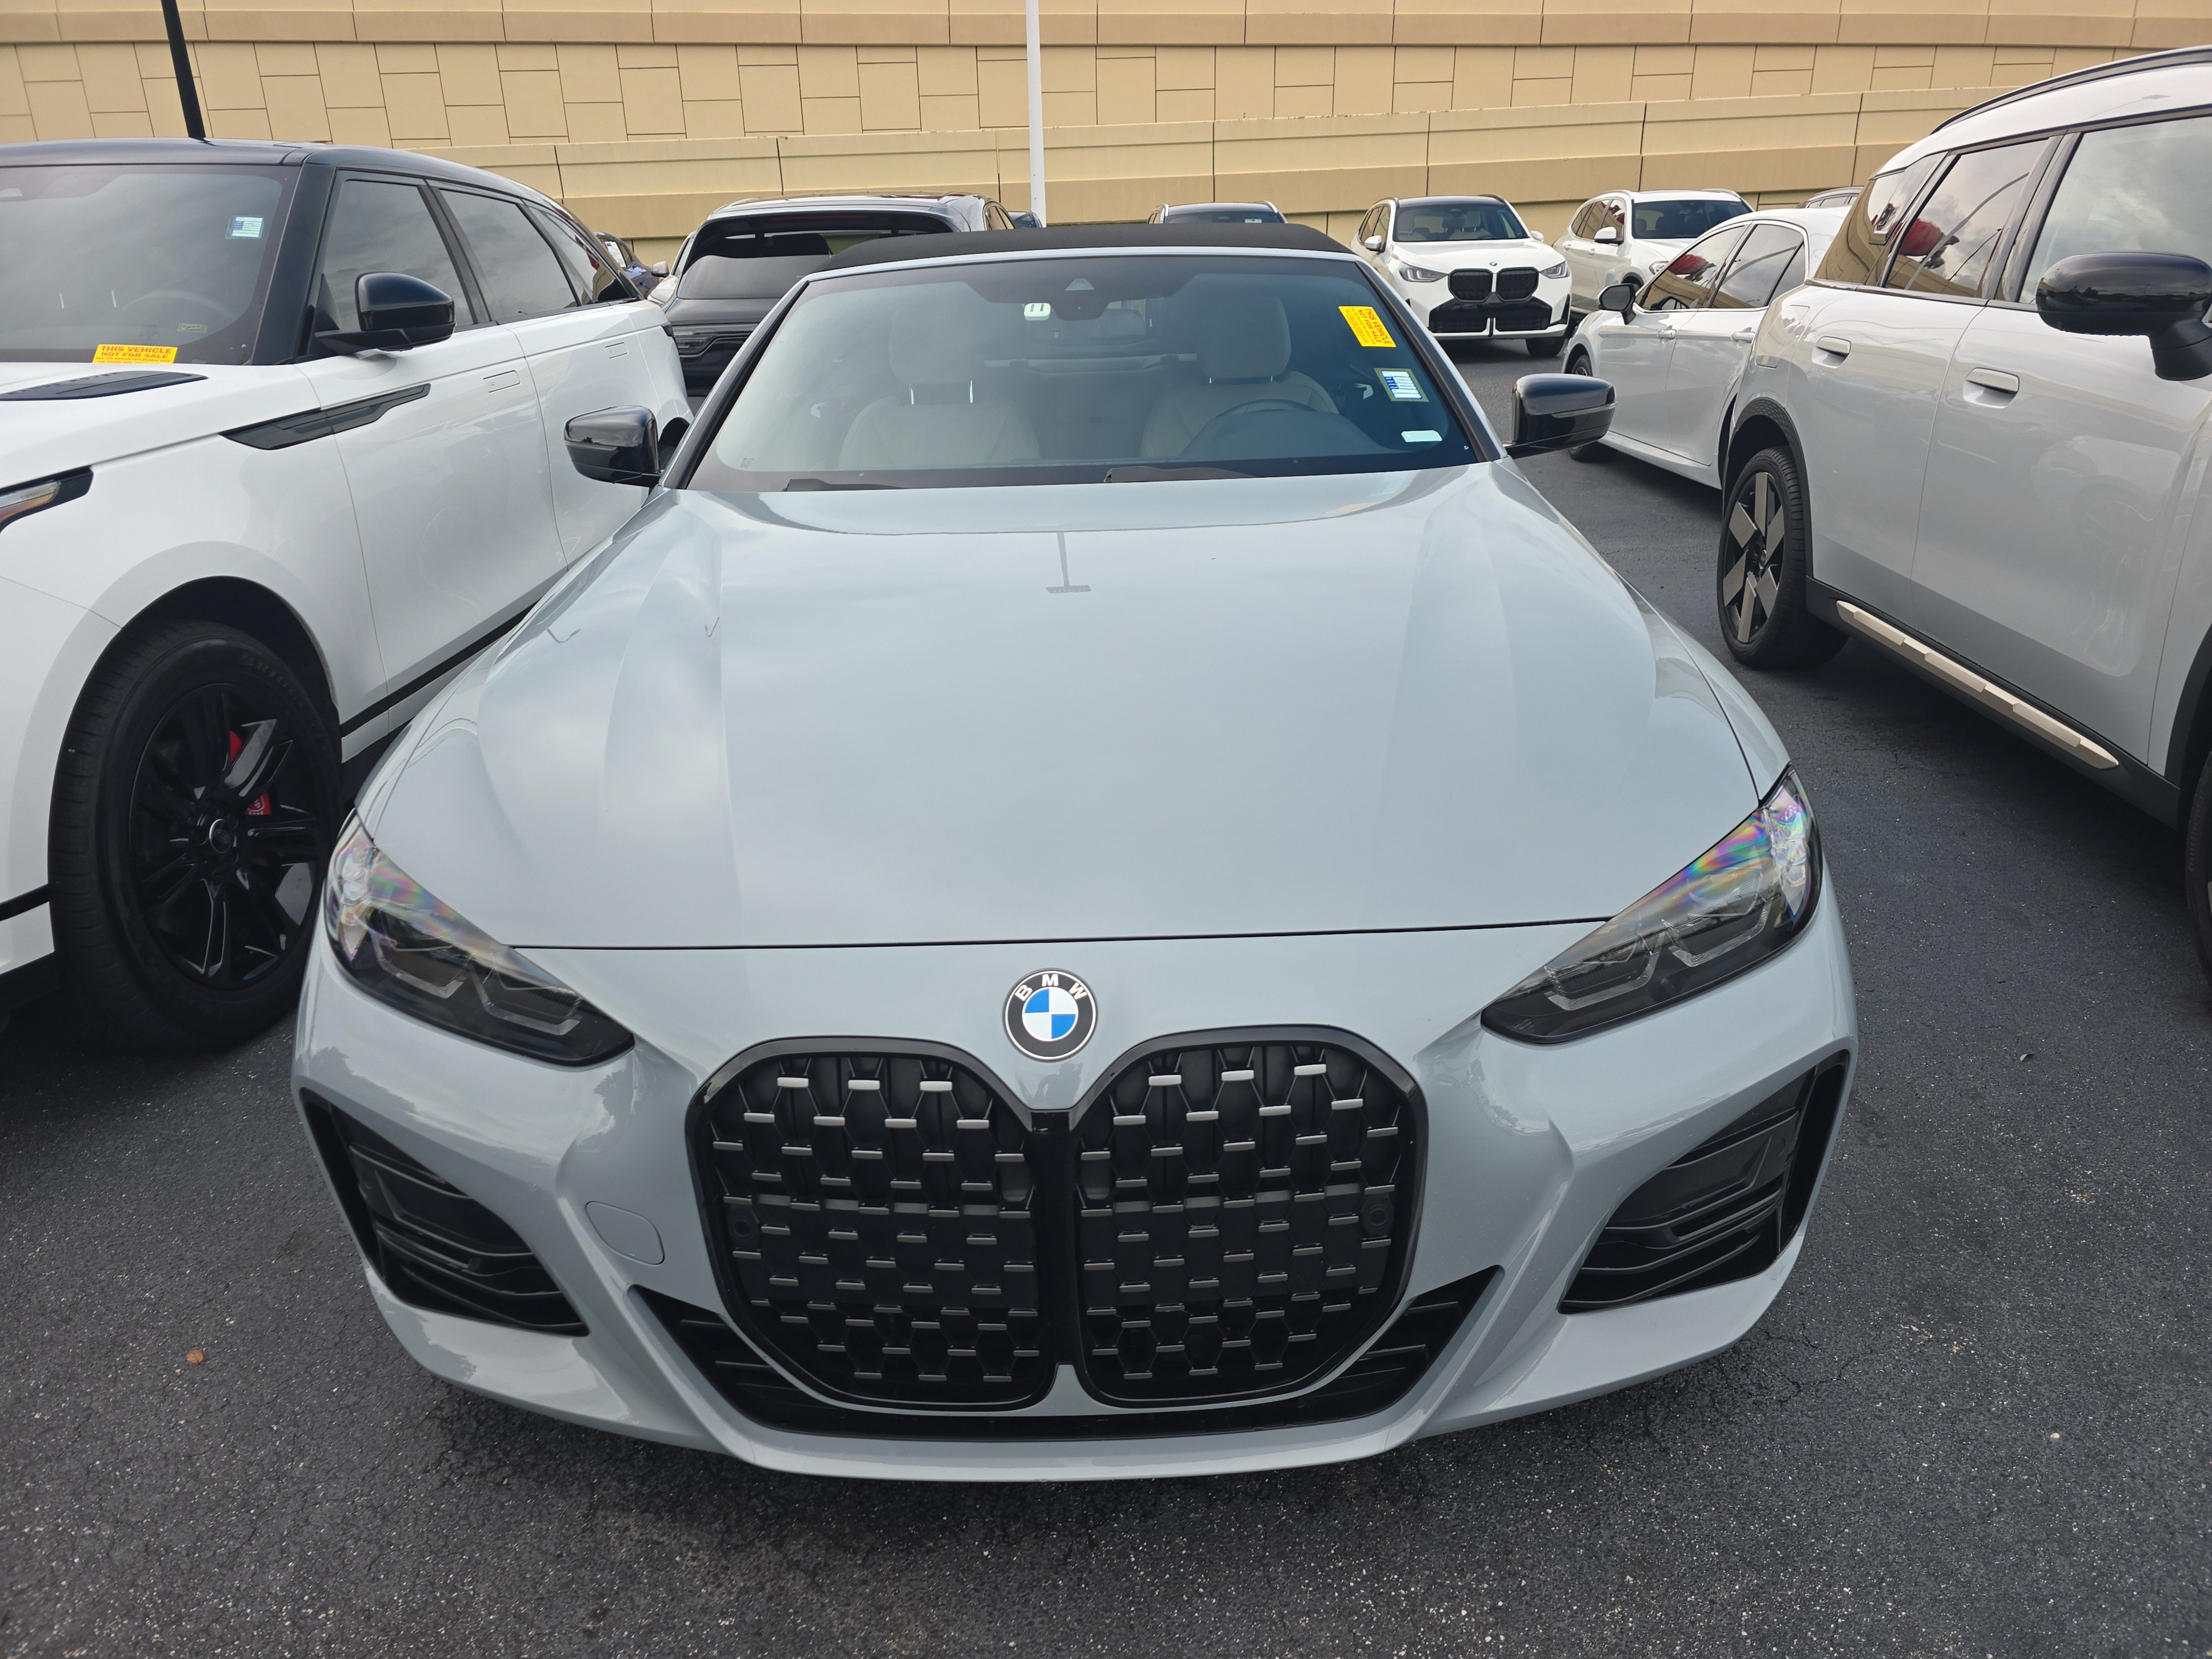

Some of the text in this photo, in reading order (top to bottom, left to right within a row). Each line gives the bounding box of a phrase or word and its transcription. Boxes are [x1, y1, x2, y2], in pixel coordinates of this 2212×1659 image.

[1358, 310, 1367, 318] NOT
[1364, 320, 1374, 330] FOR
[1371, 331, 1382, 343] SALE
[1365, 309, 1392, 345] THIS VEHICLE
[1014, 974, 1088, 1001] BMW
